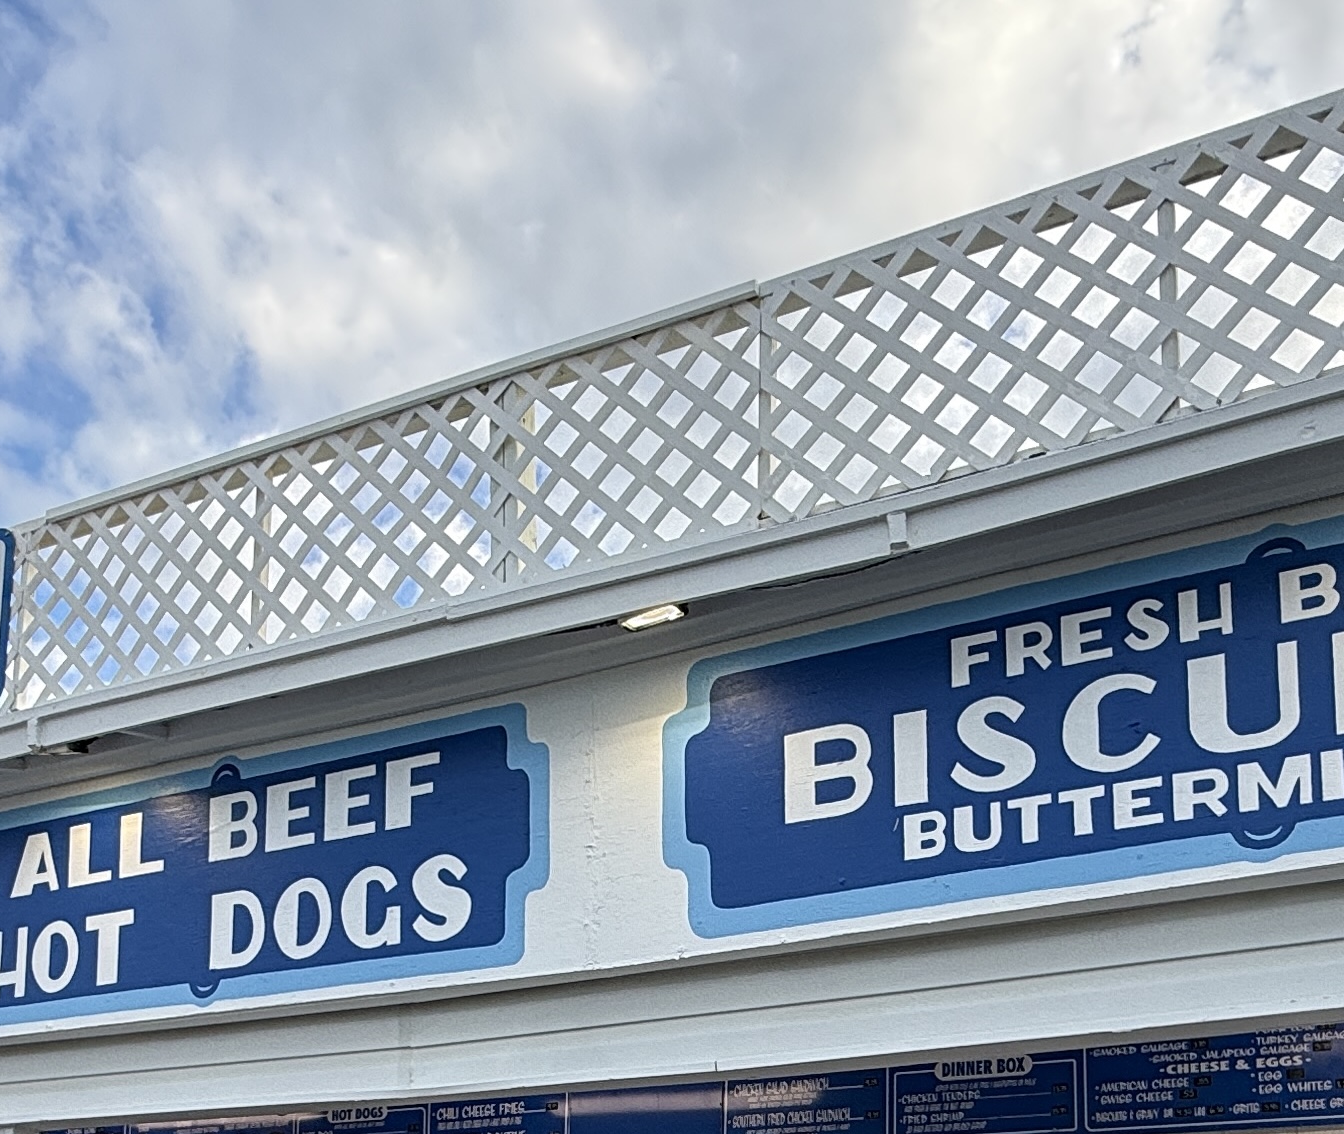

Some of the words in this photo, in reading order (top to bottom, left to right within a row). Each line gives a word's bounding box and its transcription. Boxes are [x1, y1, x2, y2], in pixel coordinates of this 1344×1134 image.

[949, 584, 1236, 690] FRESH
[10, 812, 165, 899] ALL
[208, 751, 441, 864] BEEF
[209, 853, 473, 972] DOGS
[1256, 1035, 1297, 1046] TURKEY
[1093, 1046, 1136, 1058] SMOKED
[1141, 1041, 1188, 1053] SAUSAGE
[1152, 1052, 1197, 1064] SMOKED
[1260, 1043, 1311, 1056] SAUSAGE
[942, 1060, 992, 1077] DINNER
[997, 1057, 1026, 1073] BOX
[1166, 1060, 1230, 1074] CHEESE
[1235, 1059, 1251, 1071] &
[1256, 1055, 1303, 1068] EGGS
[1258, 1071, 1282, 1082] EGG
[1100, 1080, 1148, 1093] AMERICAN
[1152, 1077, 1189, 1090] CHEESE
[1259, 1084, 1283, 1095] EGG
[1287, 1080, 1333, 1093] WHITES
[901, 1092, 938, 1104] CHICKEN
[942, 1090, 980, 1102] TENDERS
[1100, 1093, 1132, 1105] SWISS
[1136, 1091, 1173, 1102] CHEESE
[1291, 1097, 1327, 1111] CHEESE
[332, 1109, 352, 1122] HOT
[355, 1106, 383, 1120] DOGS
[436, 1106, 459, 1120] CHILI
[462, 1103, 496, 1118] CHEESE
[499, 1101, 525, 1115] FRIES
[903, 1114, 927, 1125] FRIED
[930, 1112, 964, 1122] SHRIMP
[733, 1112, 765, 1129] SOUTHERN
